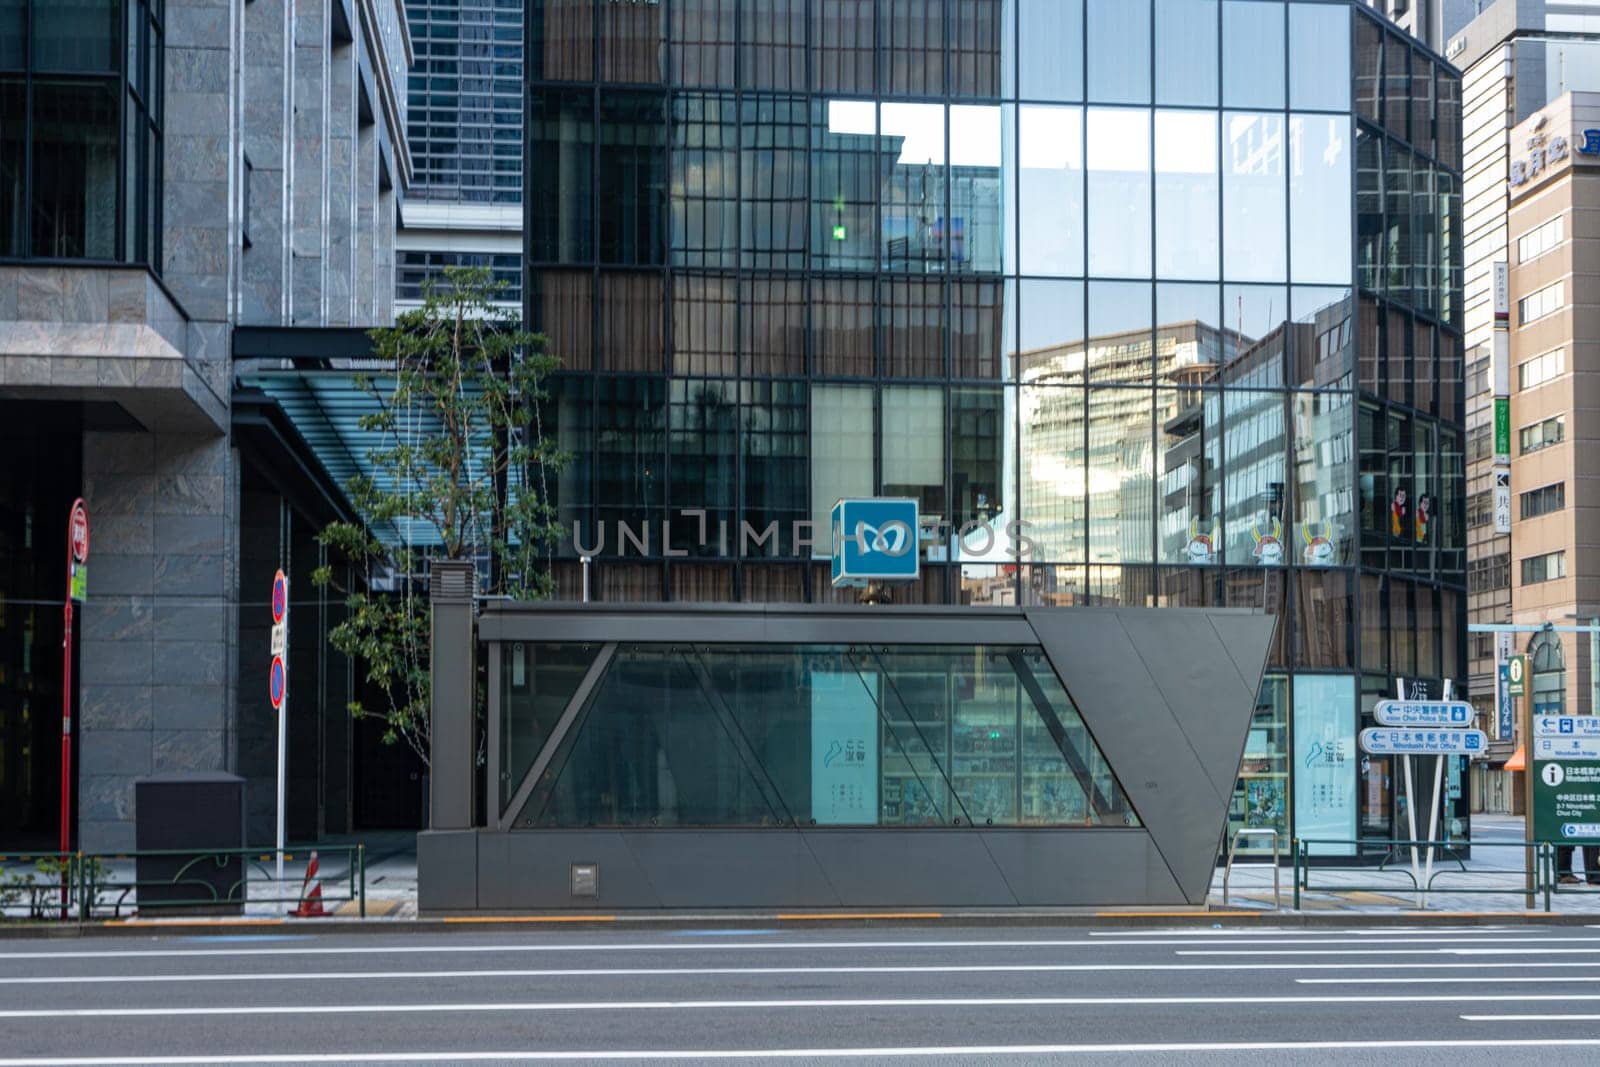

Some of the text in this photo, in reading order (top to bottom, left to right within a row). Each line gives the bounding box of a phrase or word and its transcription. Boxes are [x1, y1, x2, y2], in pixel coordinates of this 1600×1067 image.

[1390, 733, 1460, 743] 日本橋郵便局
